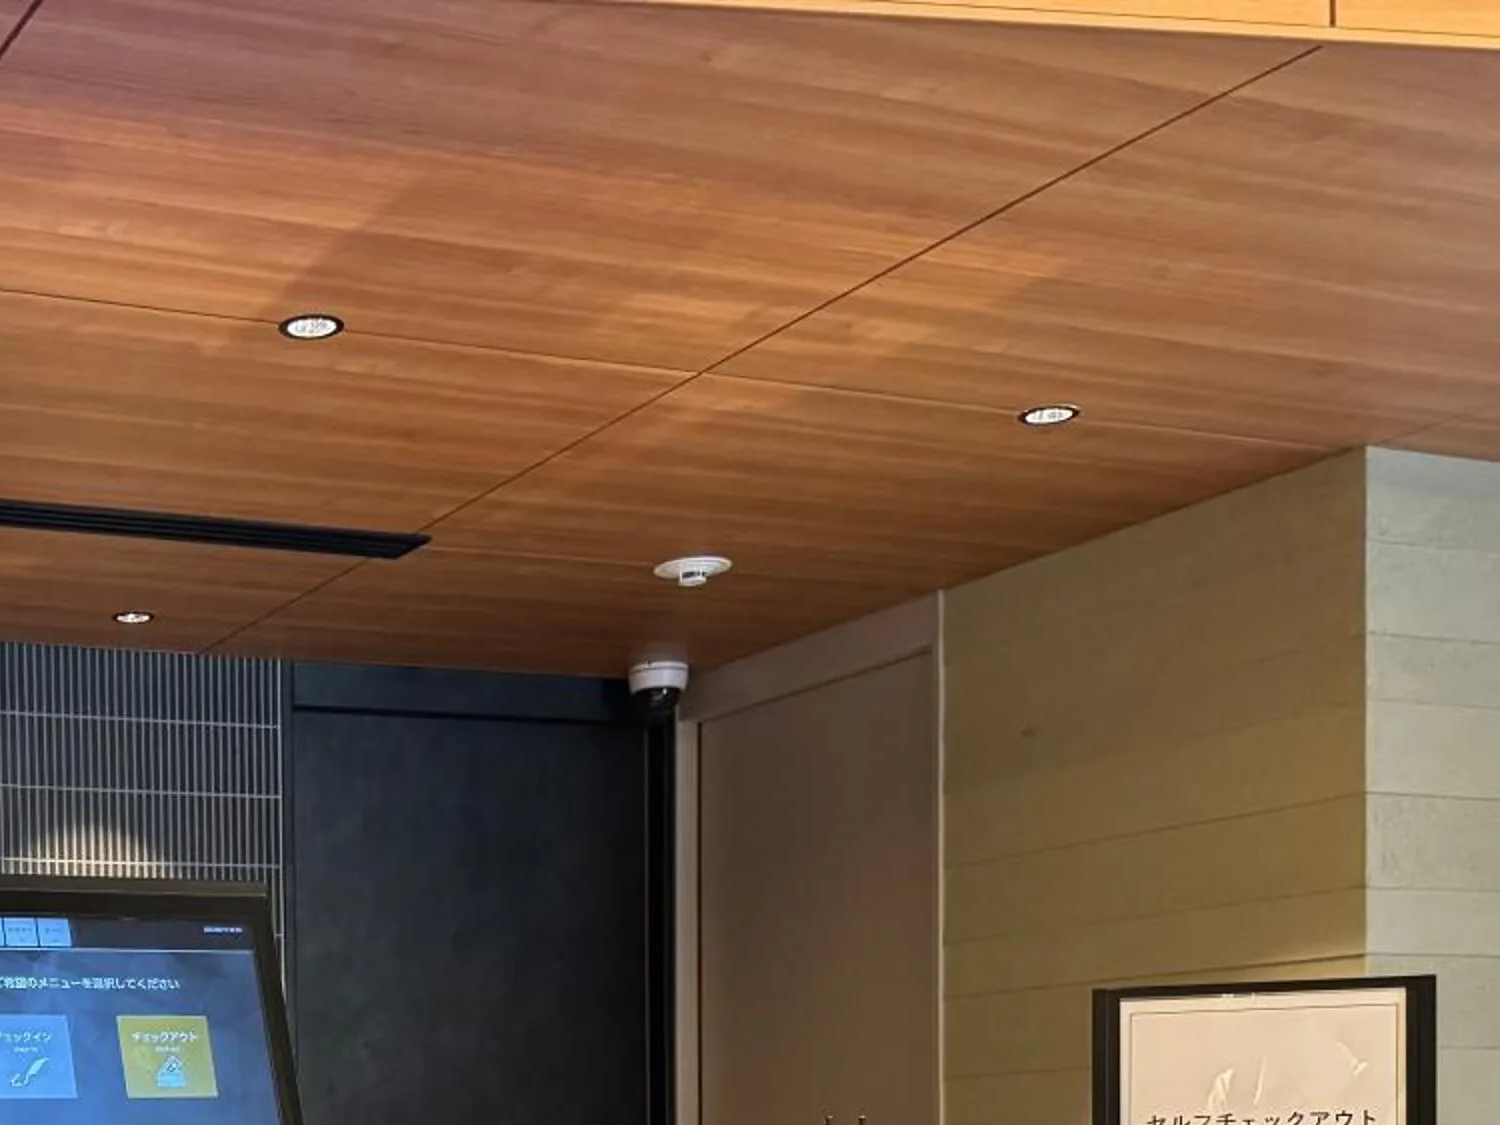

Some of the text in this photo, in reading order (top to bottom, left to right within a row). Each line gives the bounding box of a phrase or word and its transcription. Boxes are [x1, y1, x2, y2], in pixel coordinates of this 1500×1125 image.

[131, 1031, 199, 1043] チェックアウト
